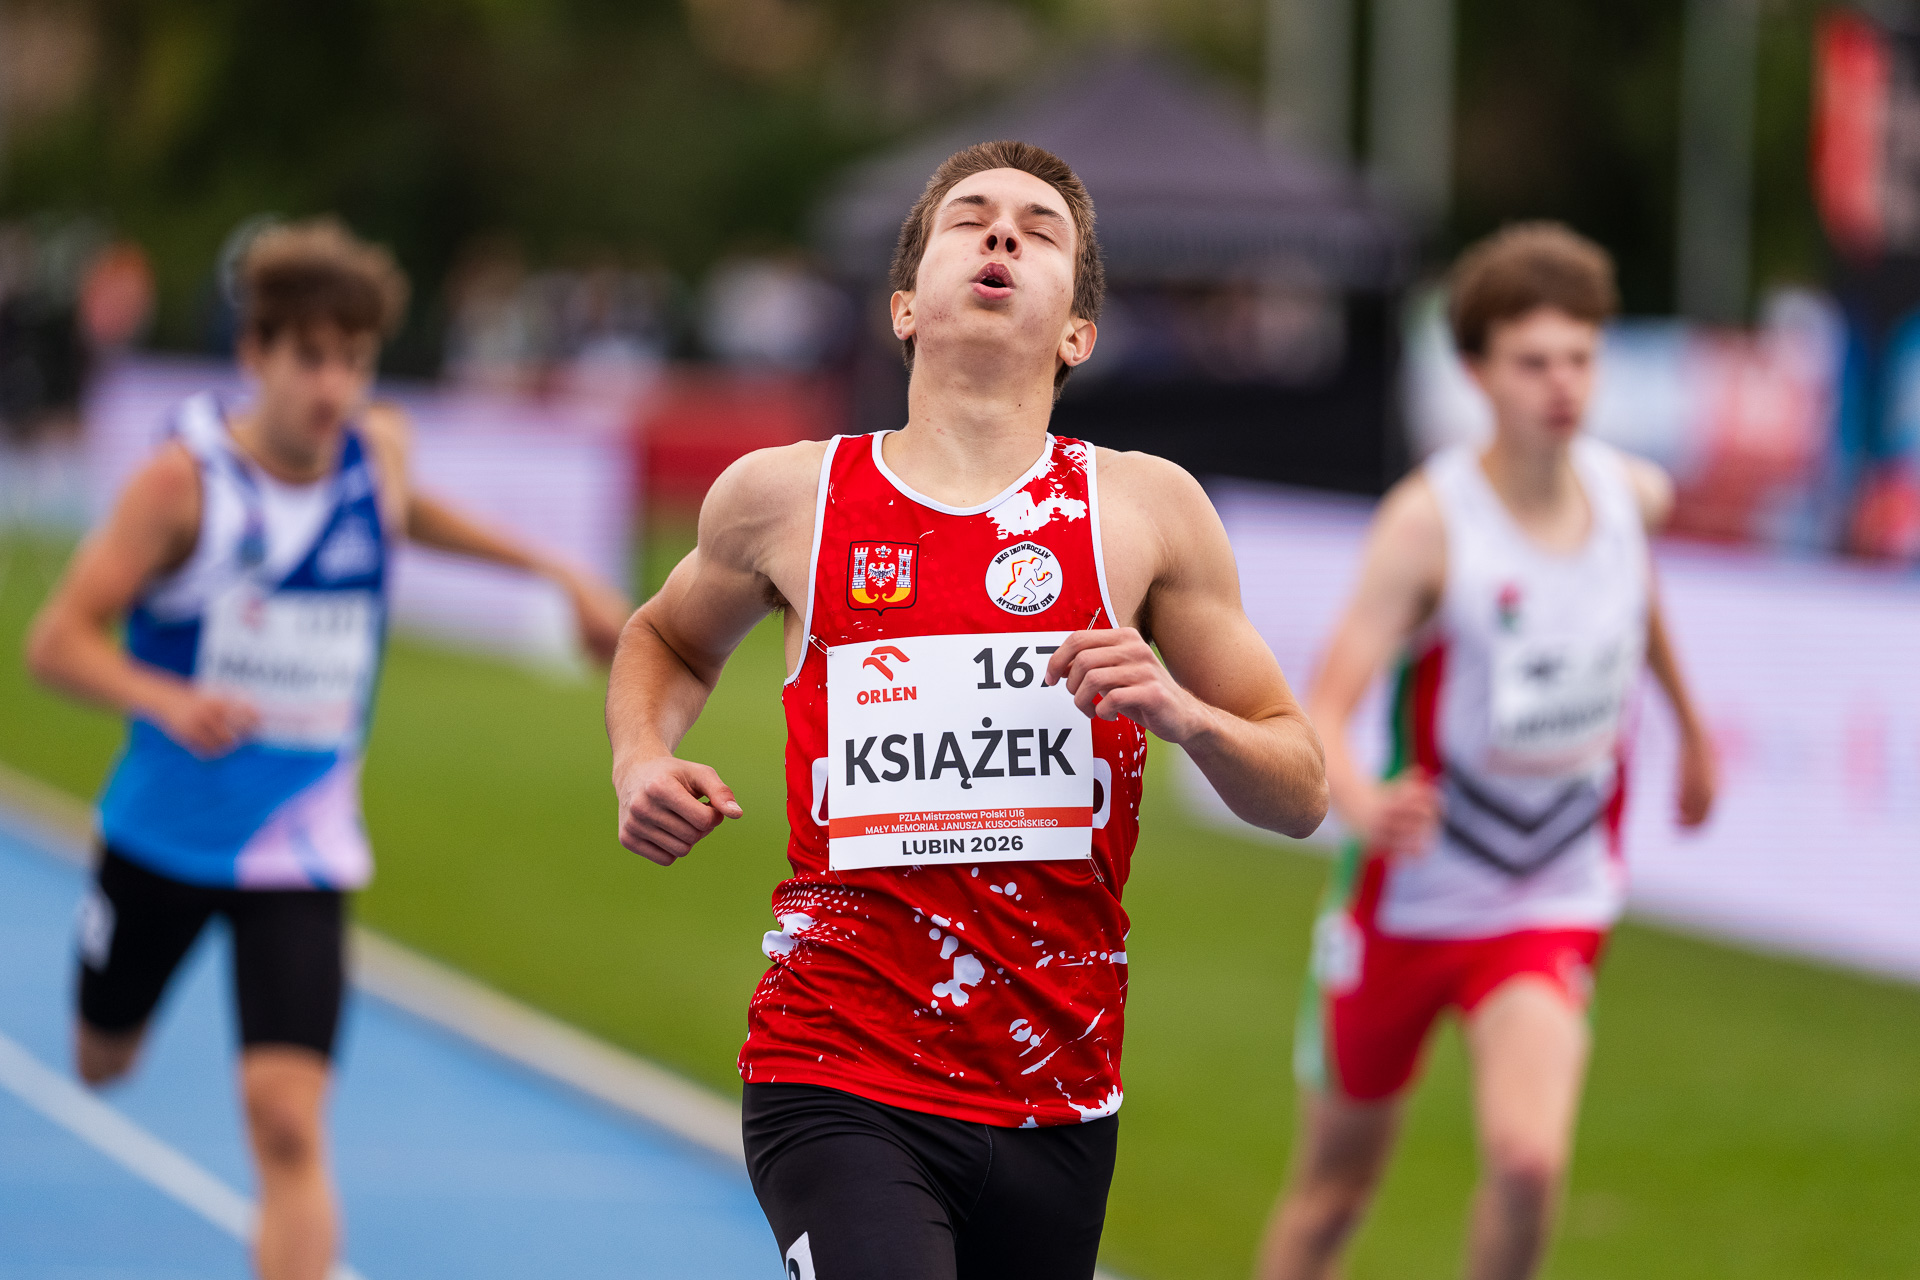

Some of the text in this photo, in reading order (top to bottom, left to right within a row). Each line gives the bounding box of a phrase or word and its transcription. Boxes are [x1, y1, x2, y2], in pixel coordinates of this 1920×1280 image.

[856, 686, 918, 705] ORLEN
[845, 716, 1077, 790] KSIĄŻEK
[899, 808, 1025, 822] PZLA Mistrzostwa Polski U16
[865, 817, 1059, 835] MAŁY MEMORIAŁ JANUSZA KUSOCIŃSKIEGO
[902, 835, 1024, 856] LUBIN 2026
